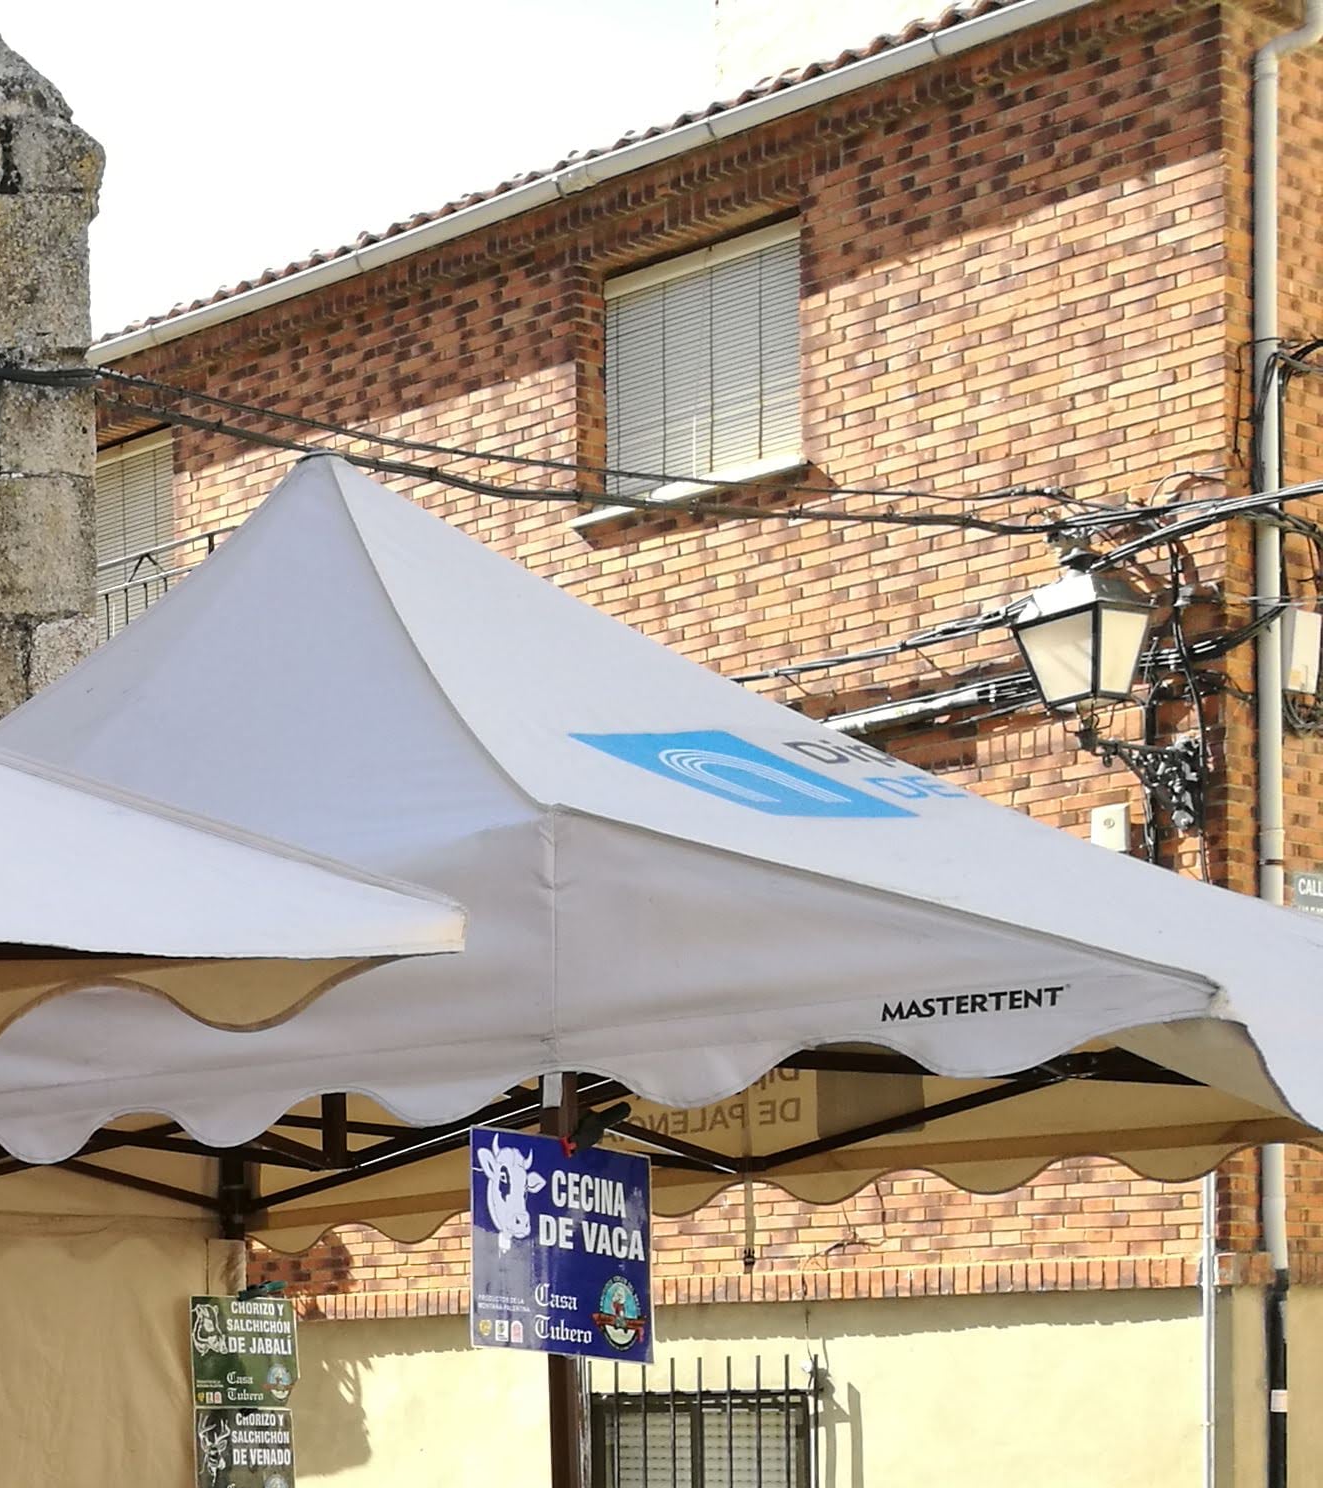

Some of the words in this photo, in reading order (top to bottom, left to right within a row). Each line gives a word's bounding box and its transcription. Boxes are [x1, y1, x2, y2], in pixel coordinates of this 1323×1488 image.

[860, 775, 969, 799] DE
[881, 986, 1064, 1022] MASTERTENT
[551, 1169, 627, 1219] CECINA
[538, 1213, 575, 1250] DE
[581, 1220, 646, 1262] VACA
[534, 1282, 579, 1312] Casa
[230, 1301, 275, 1316] CHORIZO
[277, 1303, 284, 1316] Y
[226, 1318, 291, 1334] SALCHICHÓN
[534, 1313, 593, 1345] Tubero
[228, 1336, 246, 1353] DE
[249, 1335, 292, 1355] JABALÍ
[235, 1412, 276, 1426] CHORIZO
[277, 1413, 284, 1427] Y
[231, 1427, 290, 1444] SALCHICHÓN
[232, 1448, 248, 1465] DE
[250, 1448, 291, 1466] VENADO
